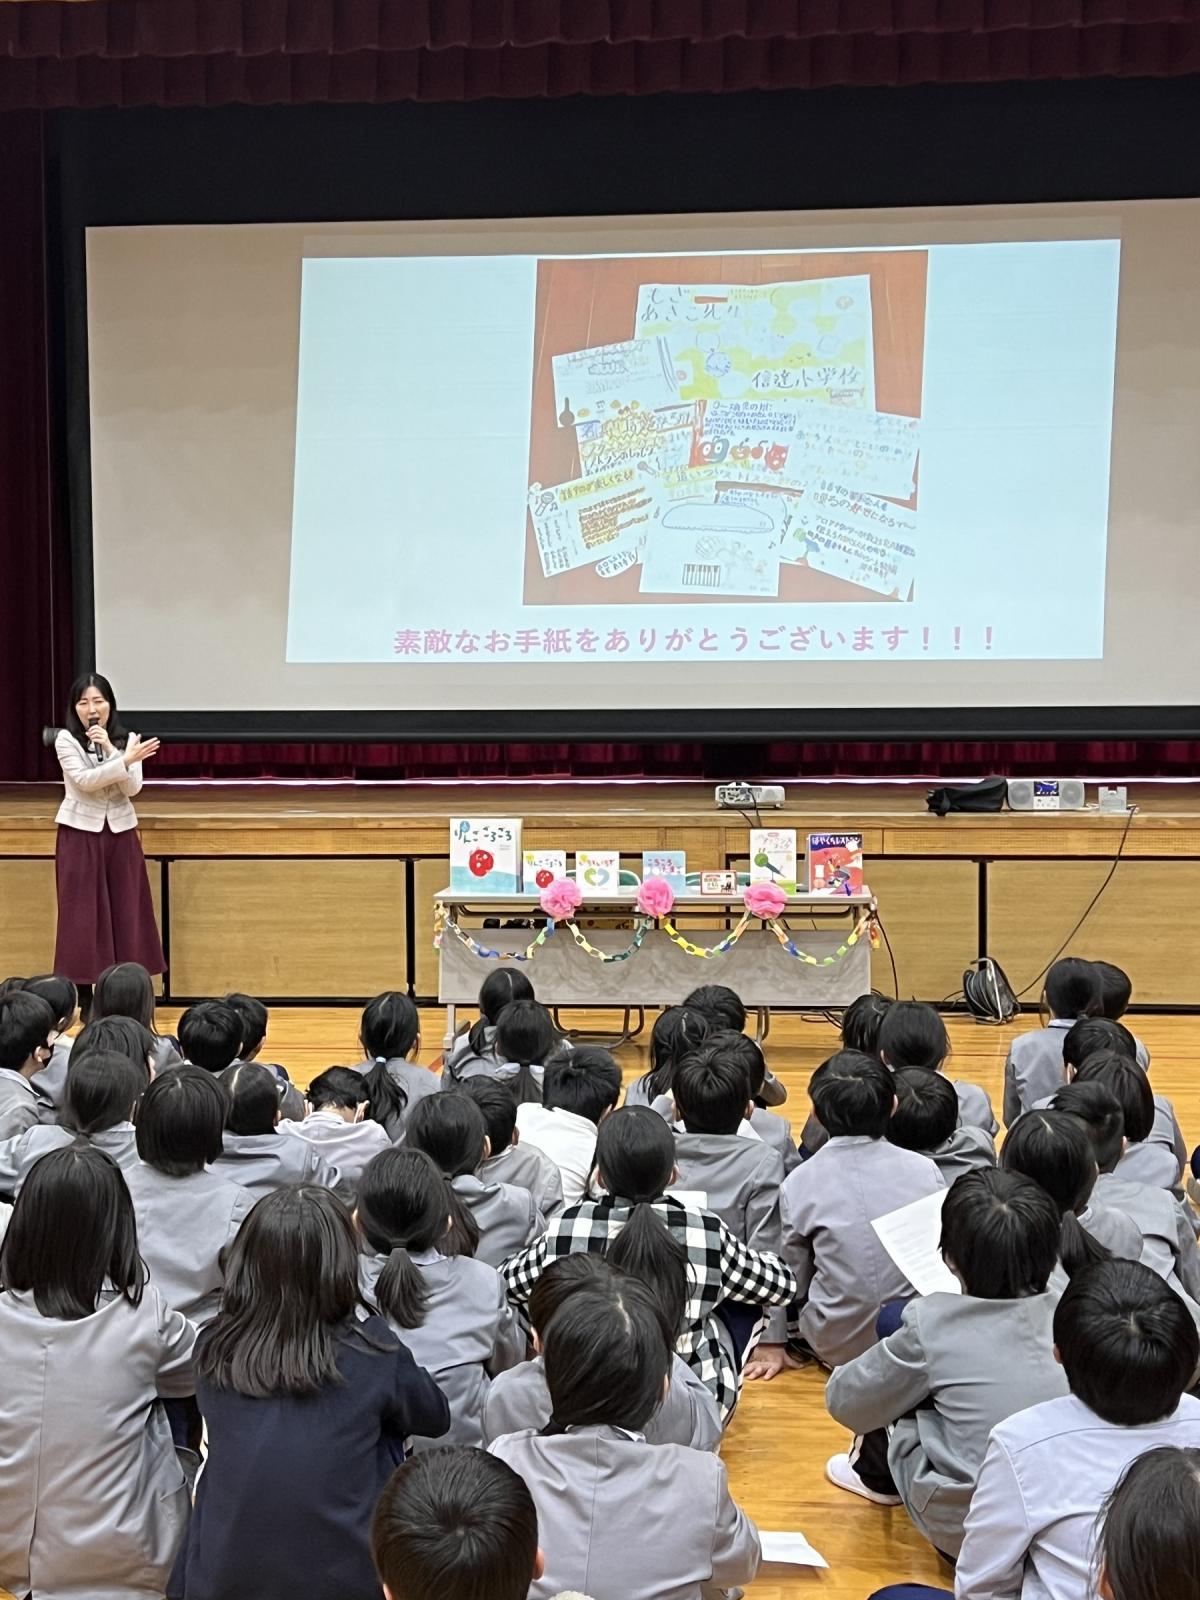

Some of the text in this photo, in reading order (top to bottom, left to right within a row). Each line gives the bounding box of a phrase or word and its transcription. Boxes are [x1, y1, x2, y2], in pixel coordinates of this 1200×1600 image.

[394, 626, 995, 655] 素敵なお手紙をありがとうございます！！！
